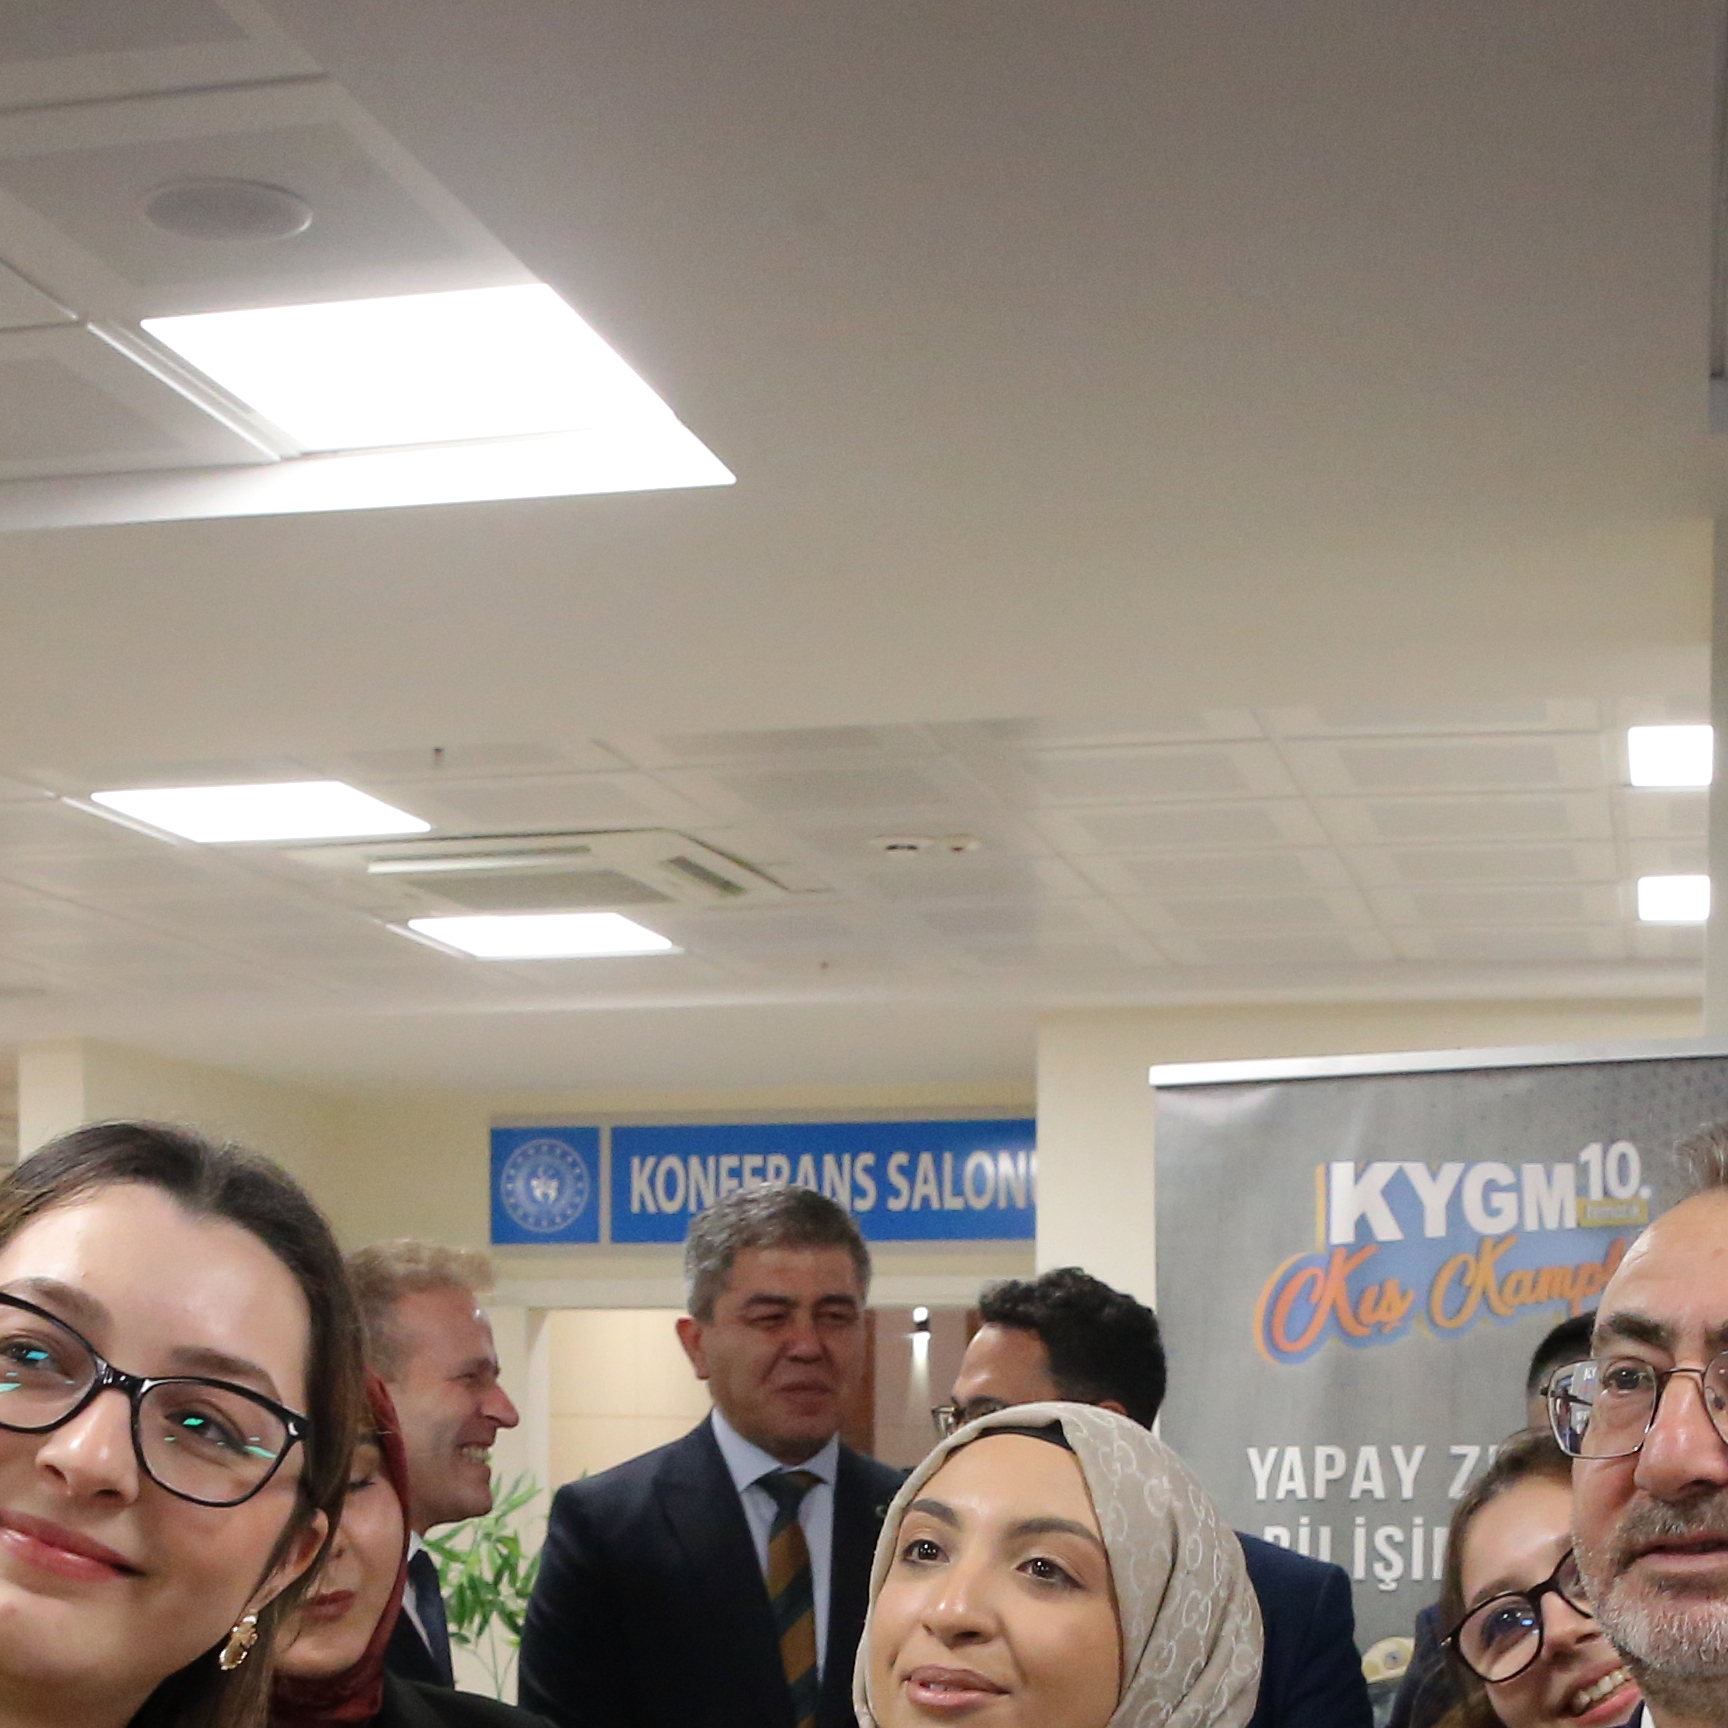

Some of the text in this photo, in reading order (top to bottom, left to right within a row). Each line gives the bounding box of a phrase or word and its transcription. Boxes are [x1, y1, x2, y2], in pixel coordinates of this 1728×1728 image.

[1329, 1139, 1653, 1245] KYGM 10.
[1272, 1245, 1414, 1353] Kış
[1246, 1445, 1426, 1500] YAPAY
